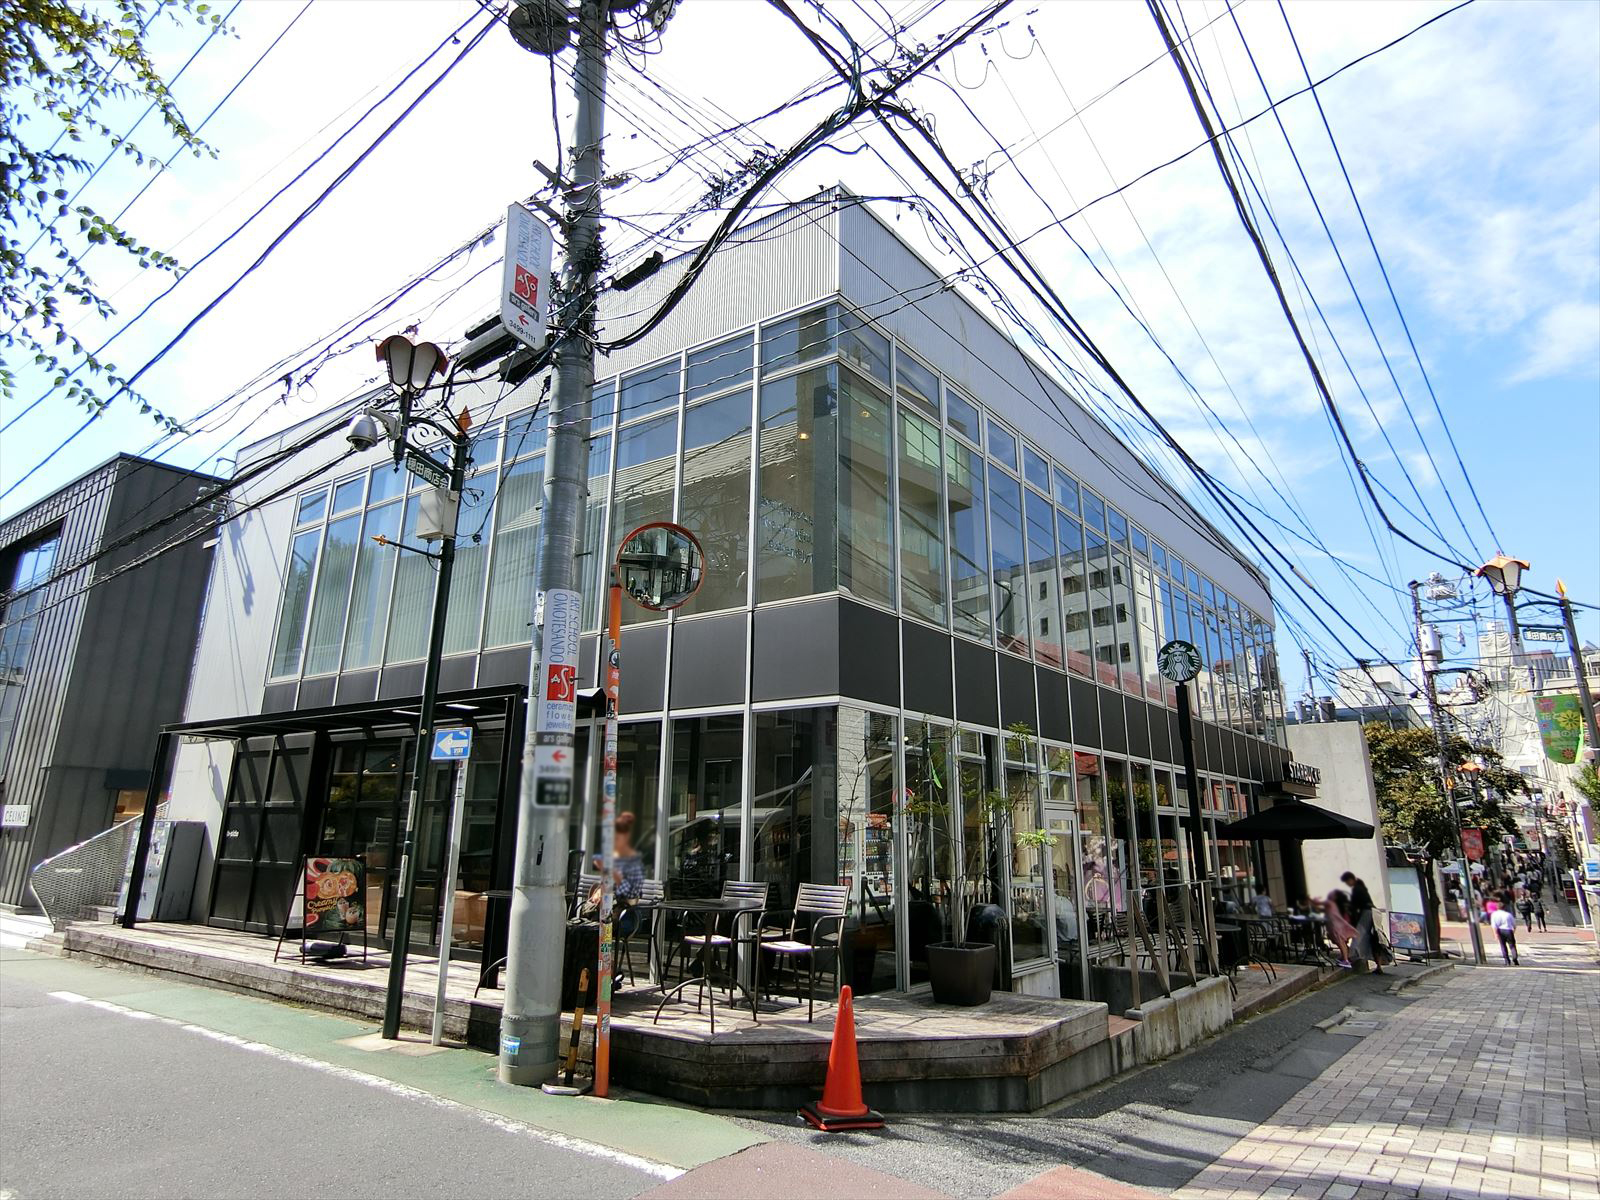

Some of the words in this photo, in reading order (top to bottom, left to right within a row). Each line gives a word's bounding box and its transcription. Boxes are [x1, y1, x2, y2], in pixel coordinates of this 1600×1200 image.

[509, 320, 536, 343] 3499-1111
[549, 592, 568, 663] OMOTESANDO
[567, 614, 580, 656] SCHOOL
[543, 734, 554, 743] ars
